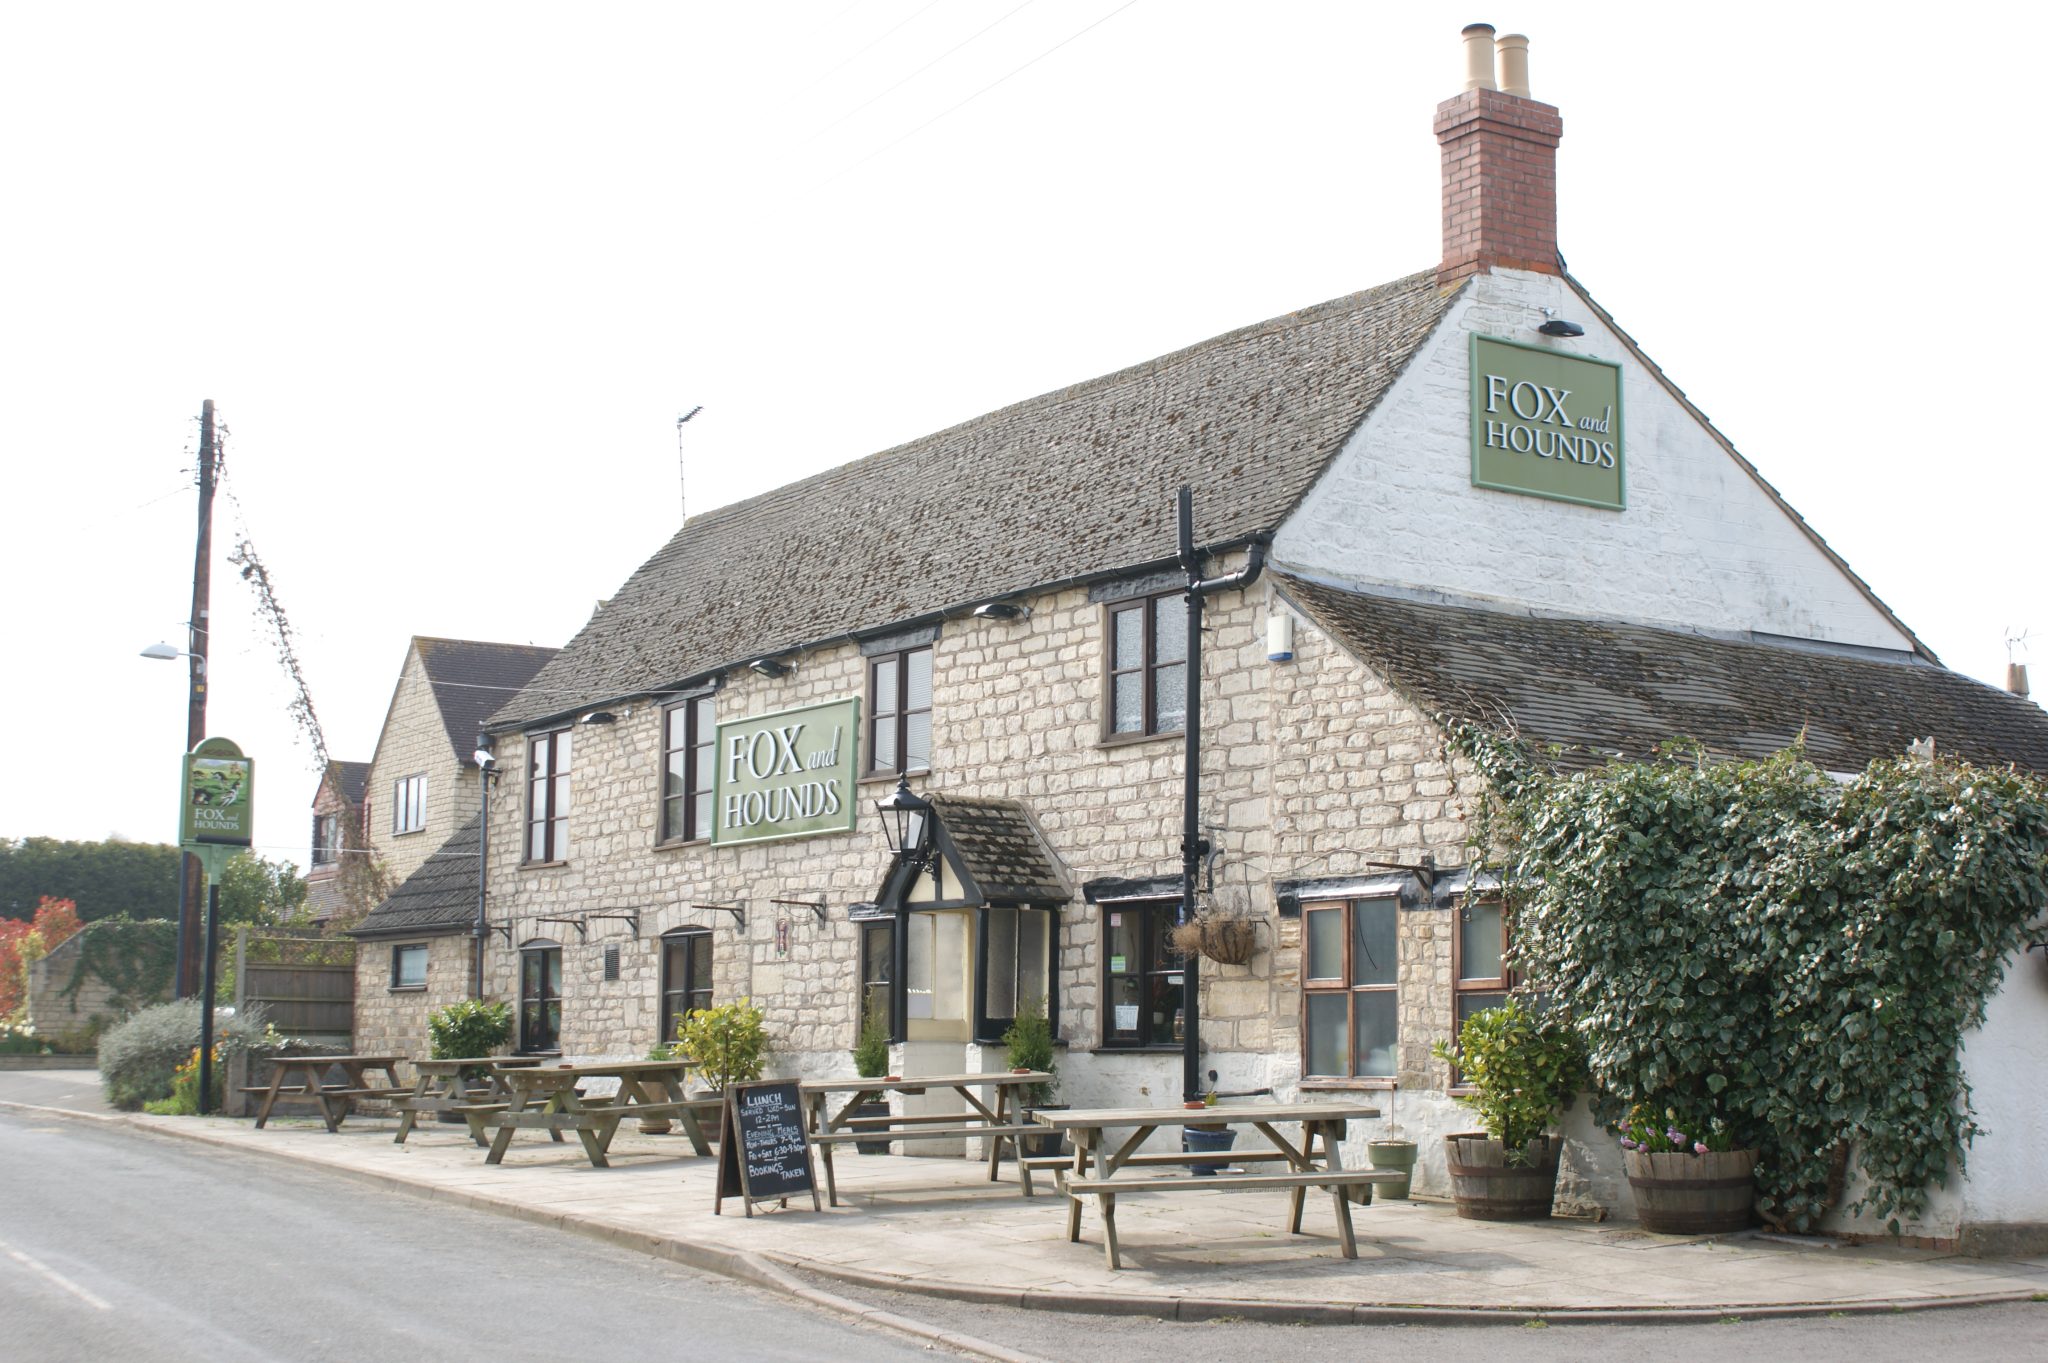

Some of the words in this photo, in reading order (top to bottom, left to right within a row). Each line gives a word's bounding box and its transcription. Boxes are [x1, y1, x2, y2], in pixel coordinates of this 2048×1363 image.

[1484, 374, 1575, 428] FOX
[1579, 405, 1612, 434] and
[1485, 419, 1615, 469] HOUNDS
[726, 723, 806, 784] FOX
[807, 725, 841, 770] and
[723, 778, 841, 829] HOUNDS
[194, 808, 225, 820] FOX
[227, 812, 240, 820] and
[193, 820, 240, 830] HOUNDS
[746, 1092, 782, 1106] LUNCH
[740, 1107, 764, 1117] SERVED
[746, 1129, 775, 1139] EVENING
[777, 1125, 799, 1137] MEALS
[748, 1162, 784, 1178] BOOKINGS
[780, 1167, 805, 1180] TAKEN
